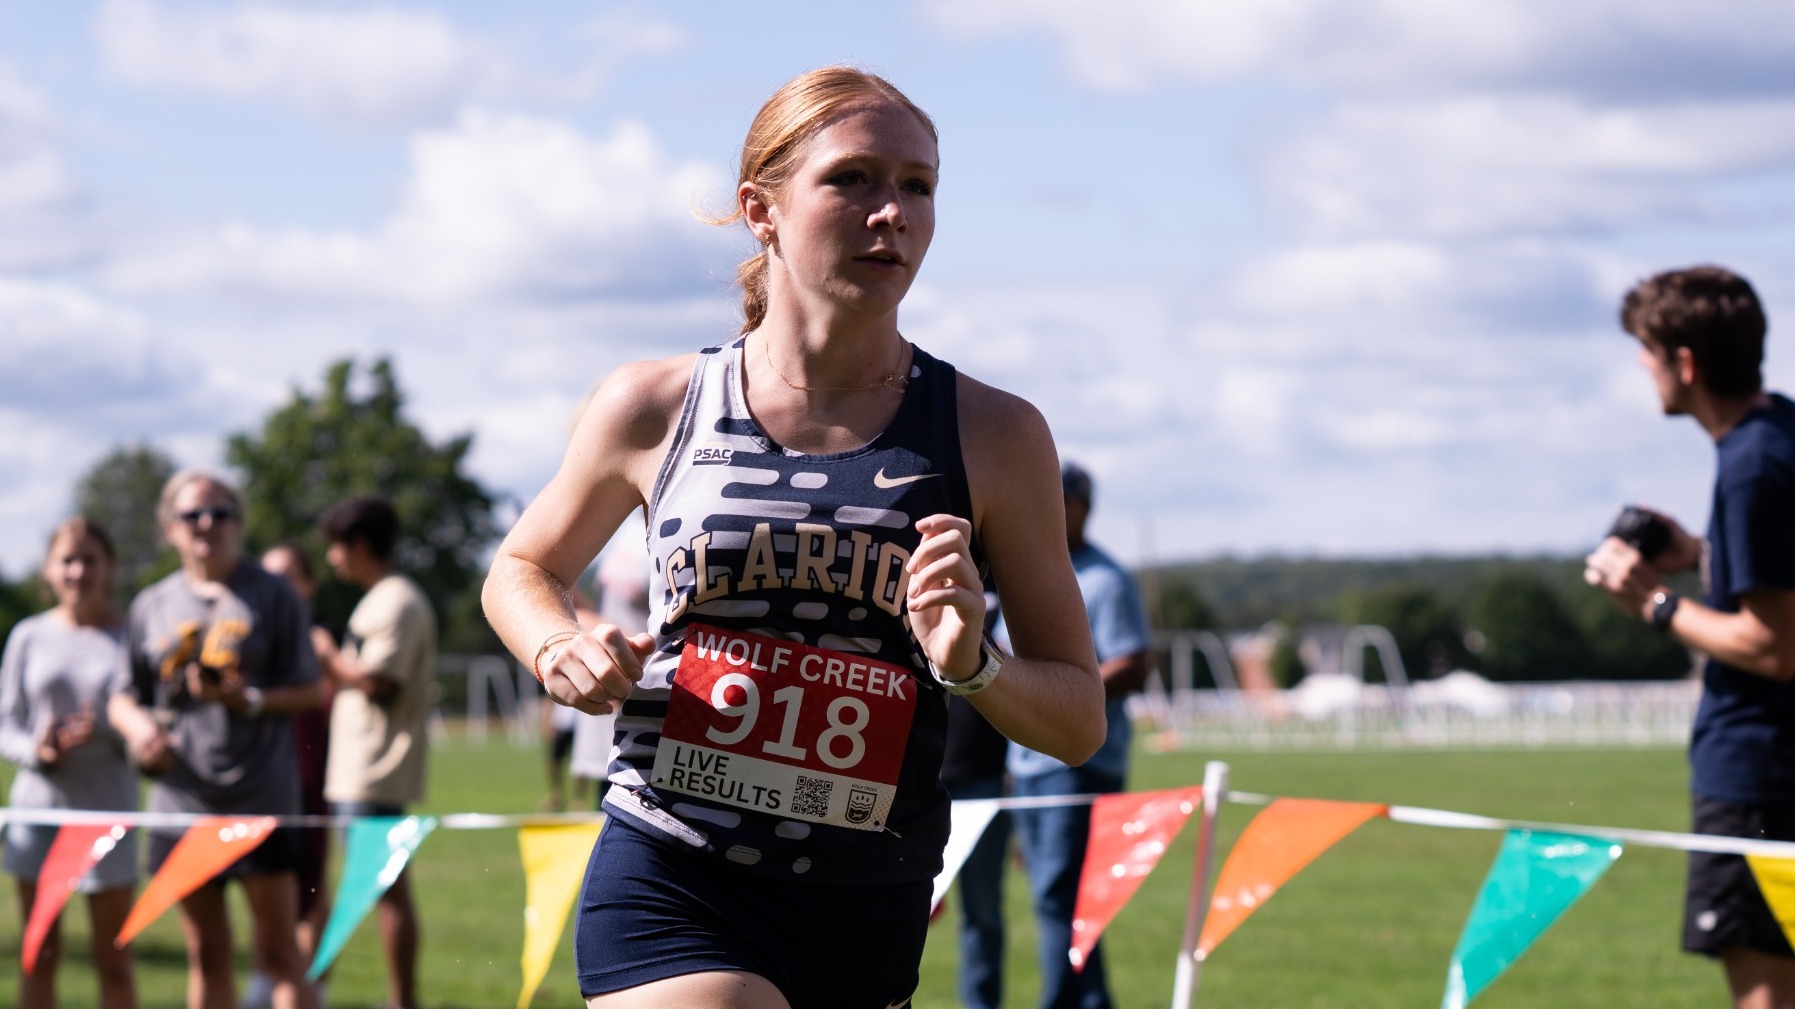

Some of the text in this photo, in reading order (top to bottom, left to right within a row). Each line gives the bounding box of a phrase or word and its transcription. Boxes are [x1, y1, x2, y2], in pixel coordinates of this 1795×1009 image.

[693, 448, 731, 460] PSAC
[665, 522, 918, 644] CLARIO
[696, 631, 907, 701] WOLF CREEK
[705, 672, 870, 770] 918
[669, 767, 782, 810] RESULTS
[673, 745, 730, 776] LIVE
